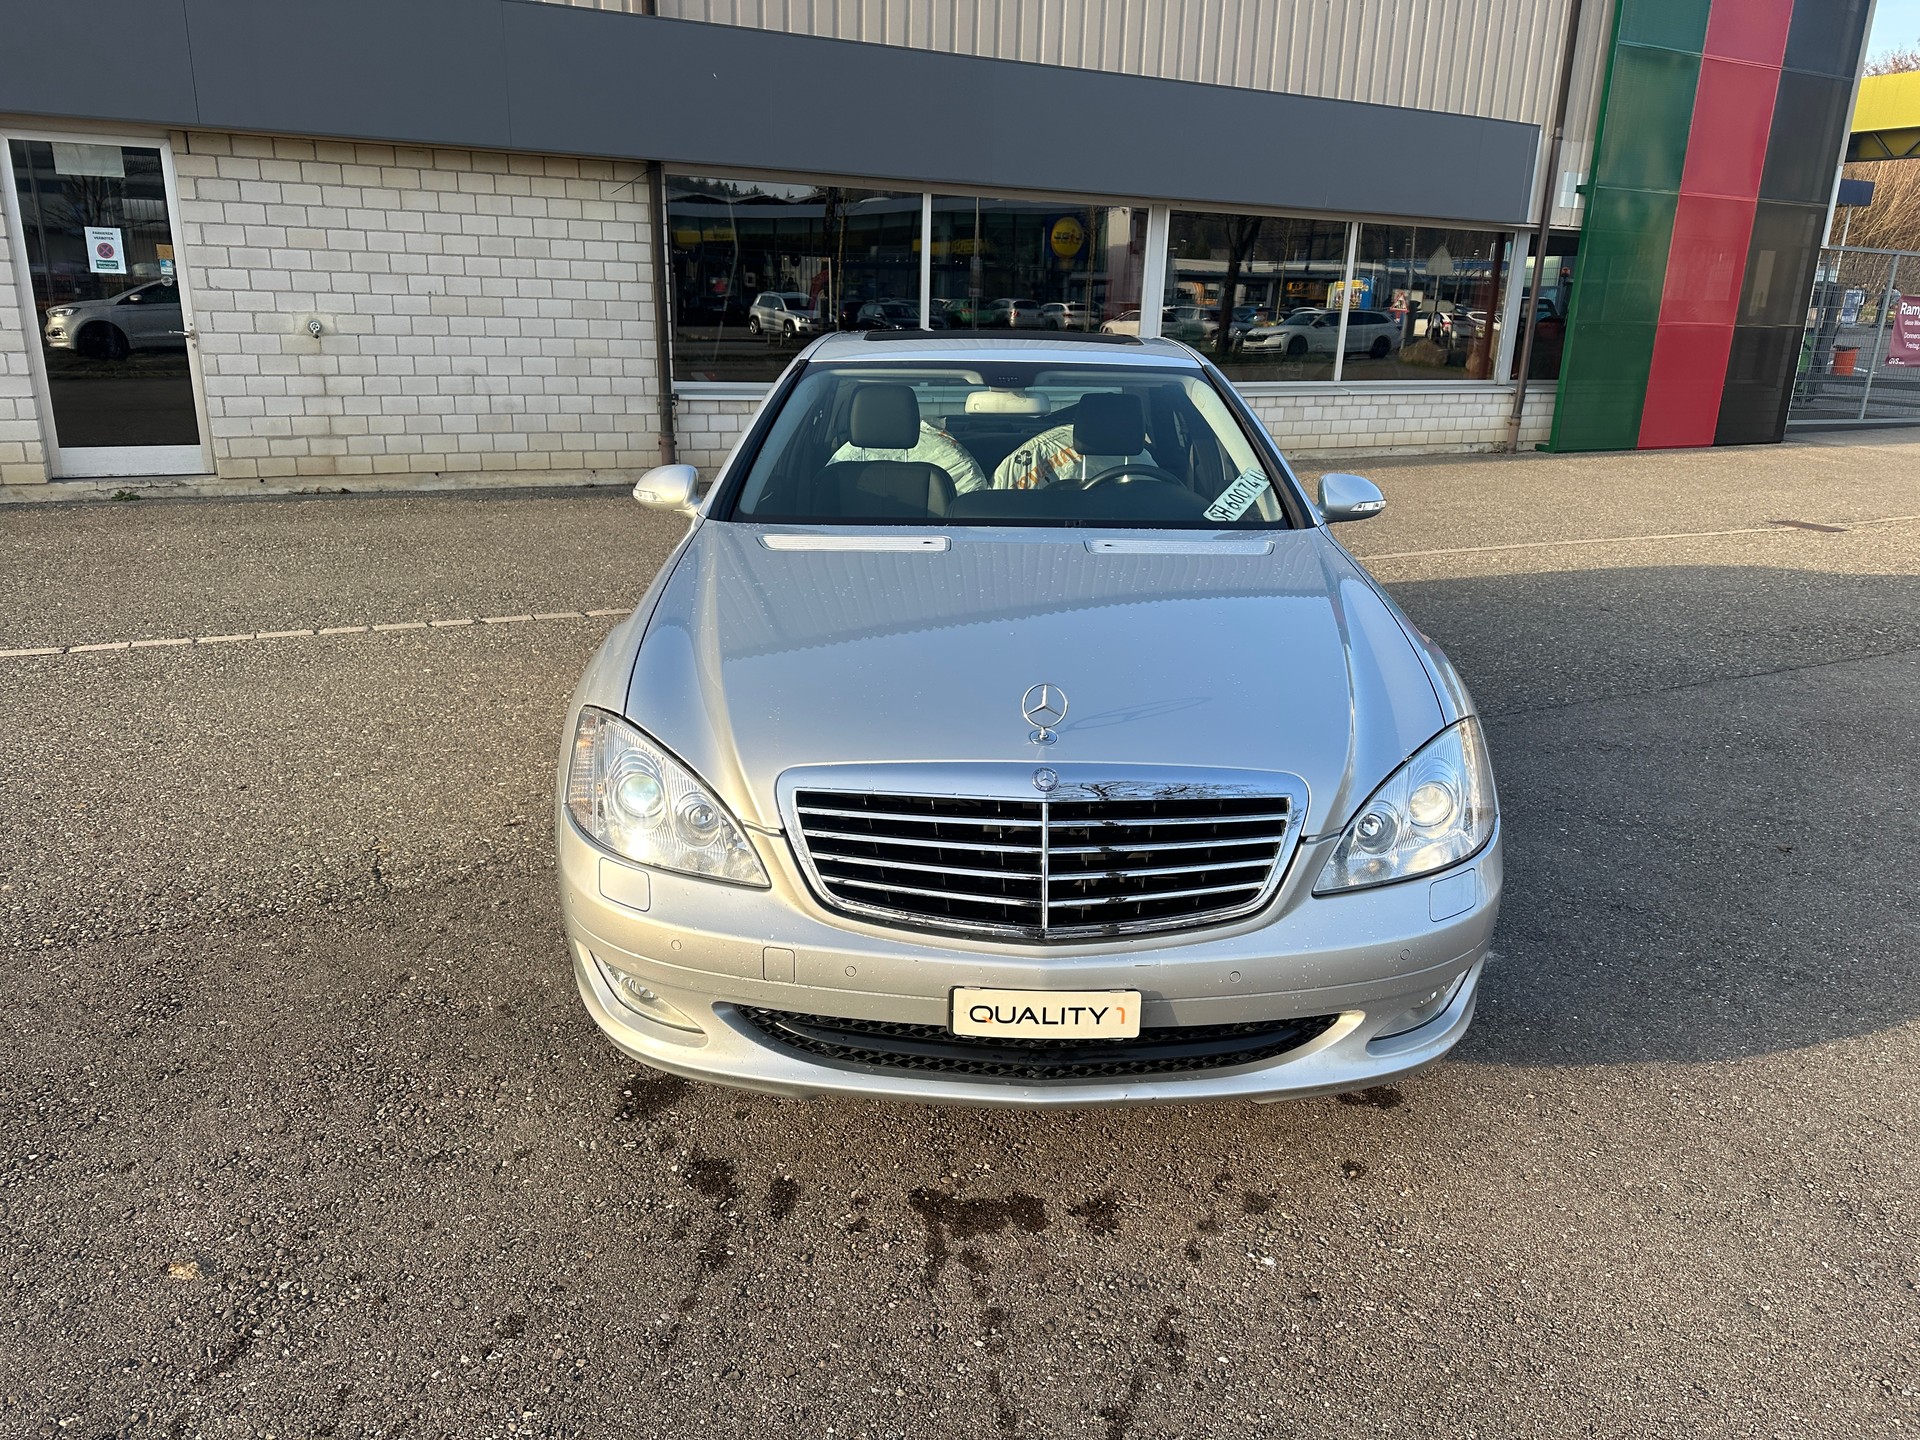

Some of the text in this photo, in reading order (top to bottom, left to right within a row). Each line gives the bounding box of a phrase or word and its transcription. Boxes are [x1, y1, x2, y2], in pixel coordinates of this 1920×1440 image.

[1900, 302, 1920, 318] Ram
[969, 1005, 1126, 1025] QUALITY 1
